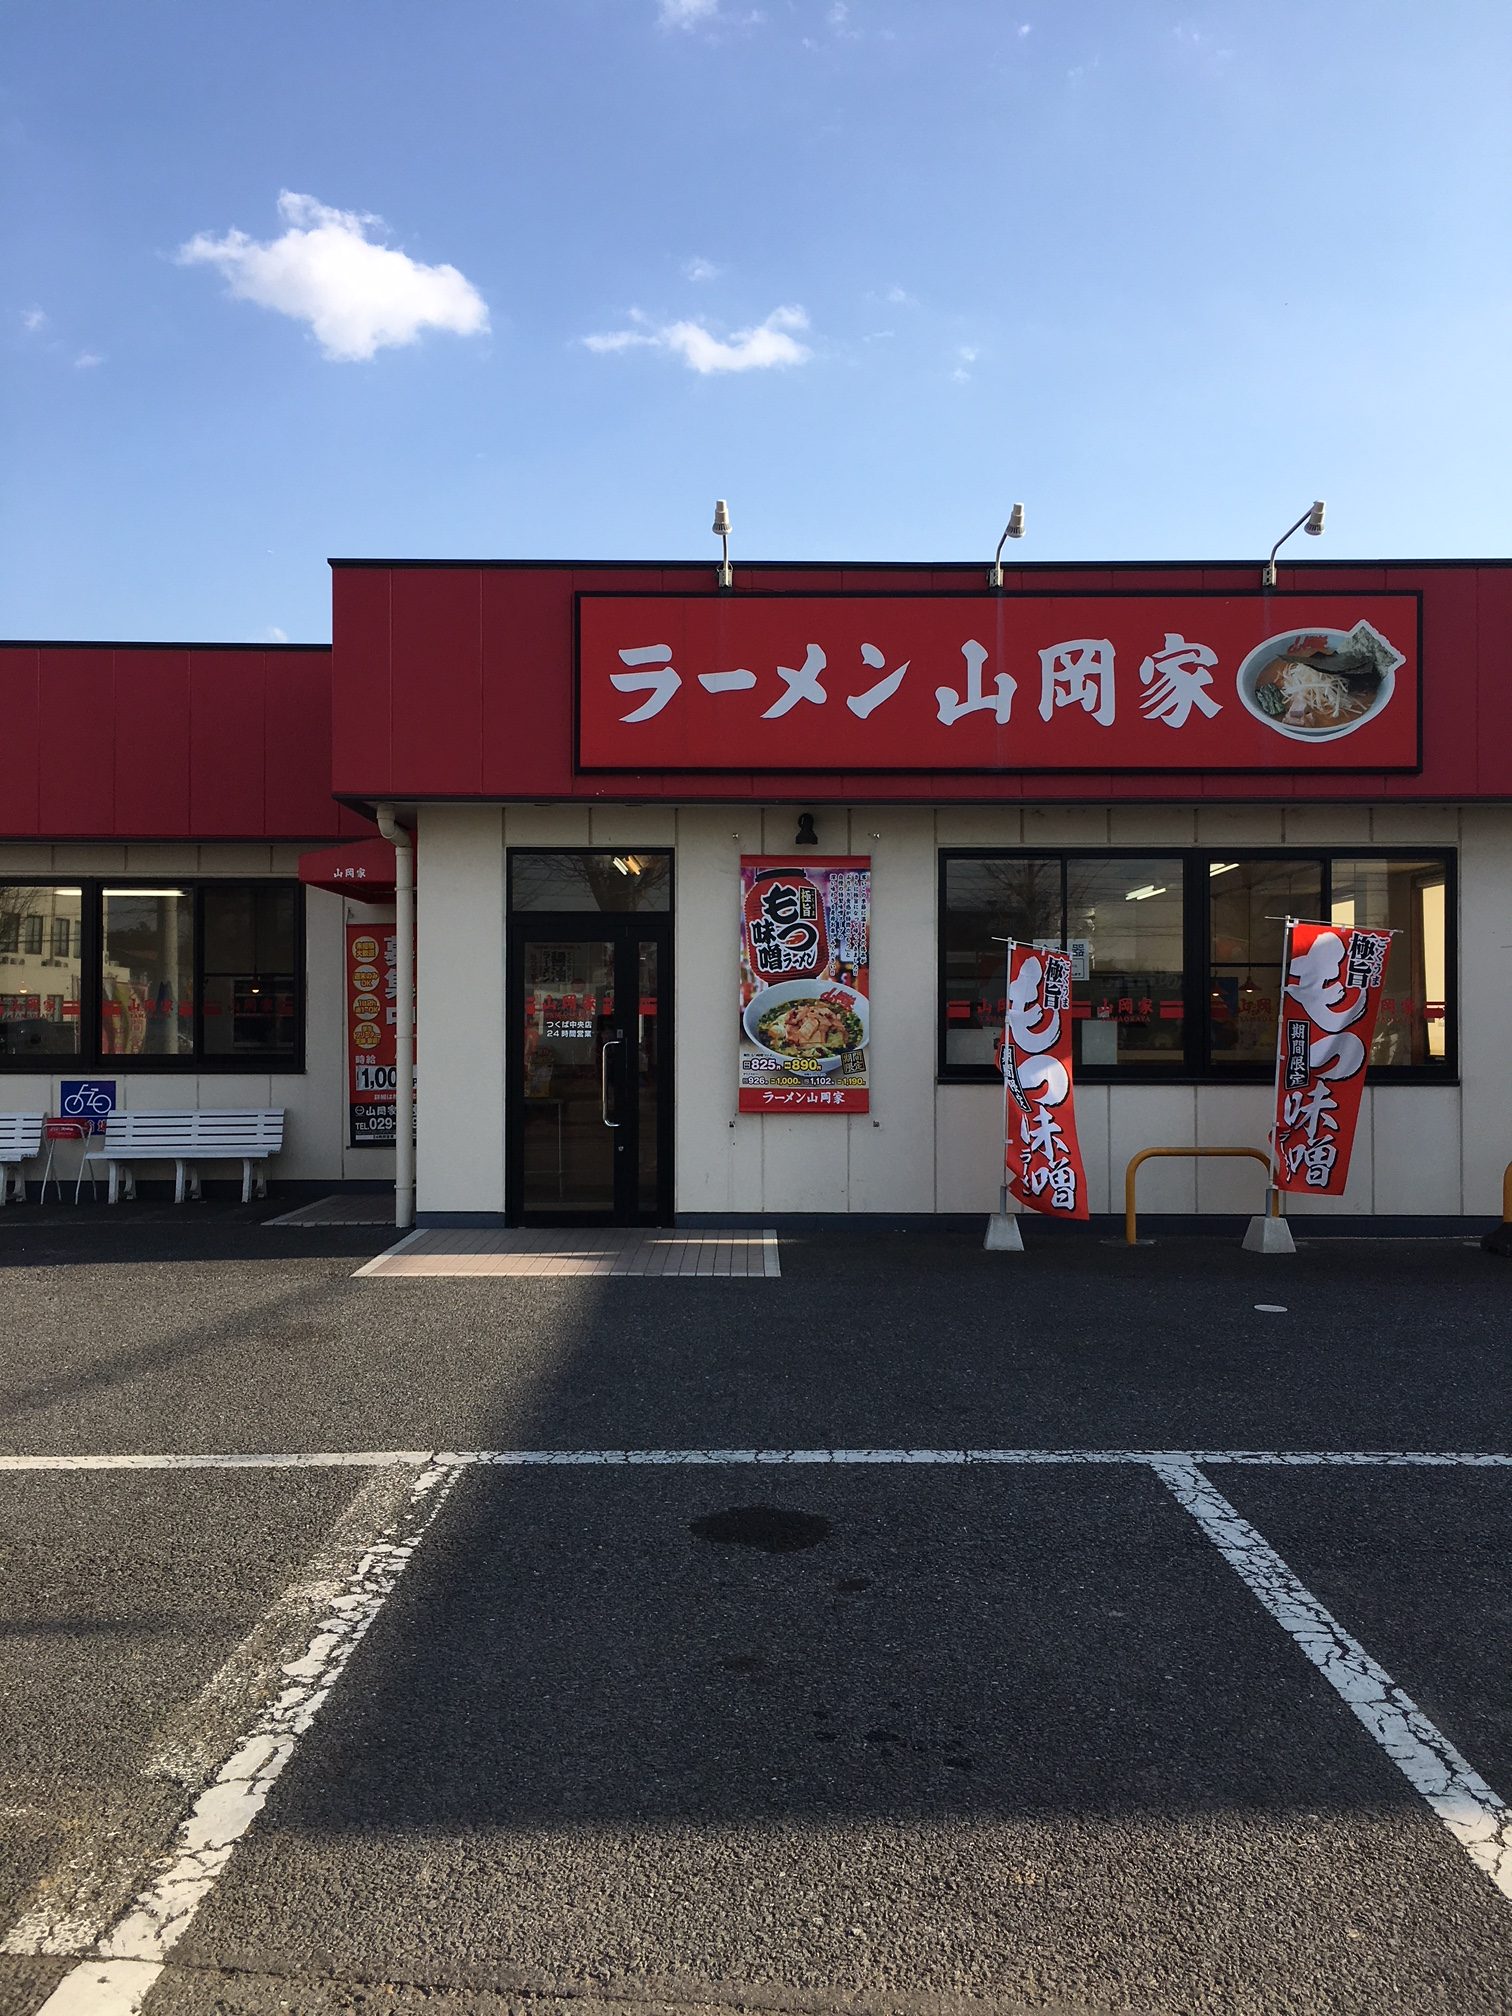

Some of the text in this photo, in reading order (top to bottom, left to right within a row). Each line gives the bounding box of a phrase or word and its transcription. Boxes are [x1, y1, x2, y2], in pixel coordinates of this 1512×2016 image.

[610, 634, 1224, 729] ラーメン山岡家
[333, 868, 367, 879] 山岡家
[762, 883, 817, 951] もつ
[750, 919, 782, 971] 味噌
[1347, 931, 1375, 988] 極旨
[1044, 956, 1063, 1009] 極旨
[1098, 998, 1153, 1015] 山岡家
[546, 1021, 592, 1029] つくば中央店
[356, 1055, 376, 1064] 時給
[1289, 1023, 1305, 1086] 期間限定
[763, 1091, 845, 1104] ラーメン山岡家
